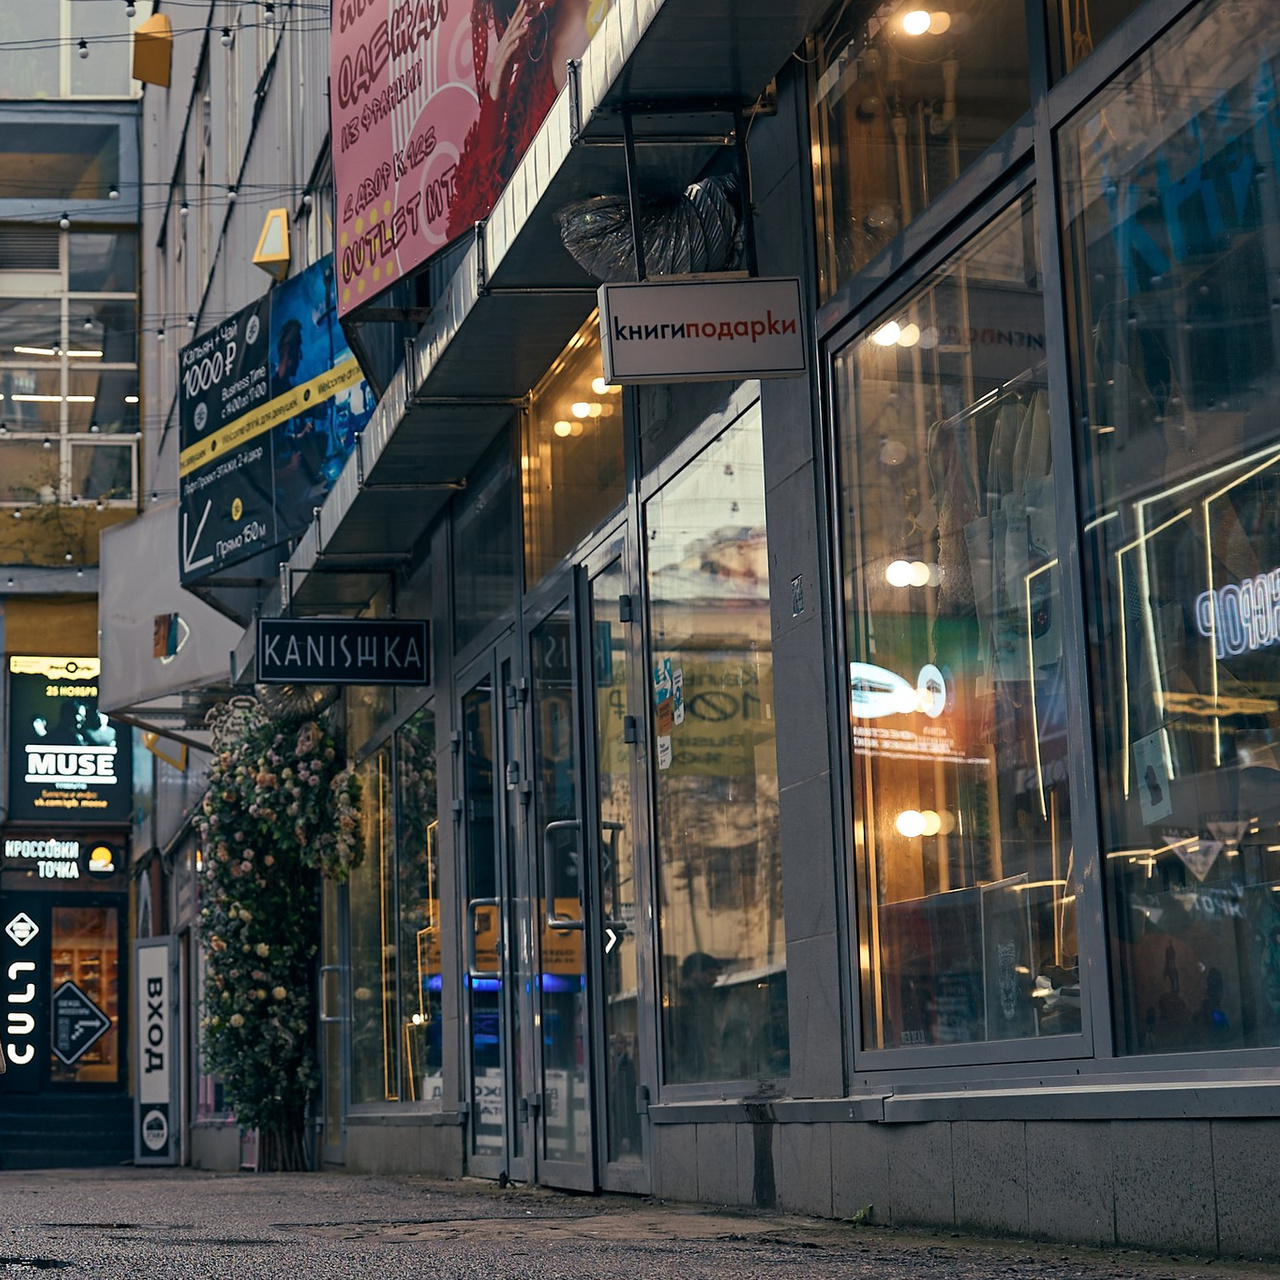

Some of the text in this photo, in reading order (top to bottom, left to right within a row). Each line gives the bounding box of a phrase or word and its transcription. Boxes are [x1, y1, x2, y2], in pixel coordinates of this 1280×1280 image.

[341, 56, 423, 155] ИЗ ФРАНЦИИ
[355, 154, 392, 217] ДВОР
[341, 194, 422, 285] OUTLET
[182, 319, 238, 368] Кальян + Чай
[183, 350, 221, 401] 1000
[221, 365, 267, 403] Business Time
[215, 533, 244, 559] Прямо
[265, 634, 422, 669] KANISHKA
[27, 753, 115, 776] MUSE
[4, 839, 80, 859] КРОССОВКИ
[36, 860, 80, 879] ТОЧКА
[145, 976, 164, 1074] ВХОД
